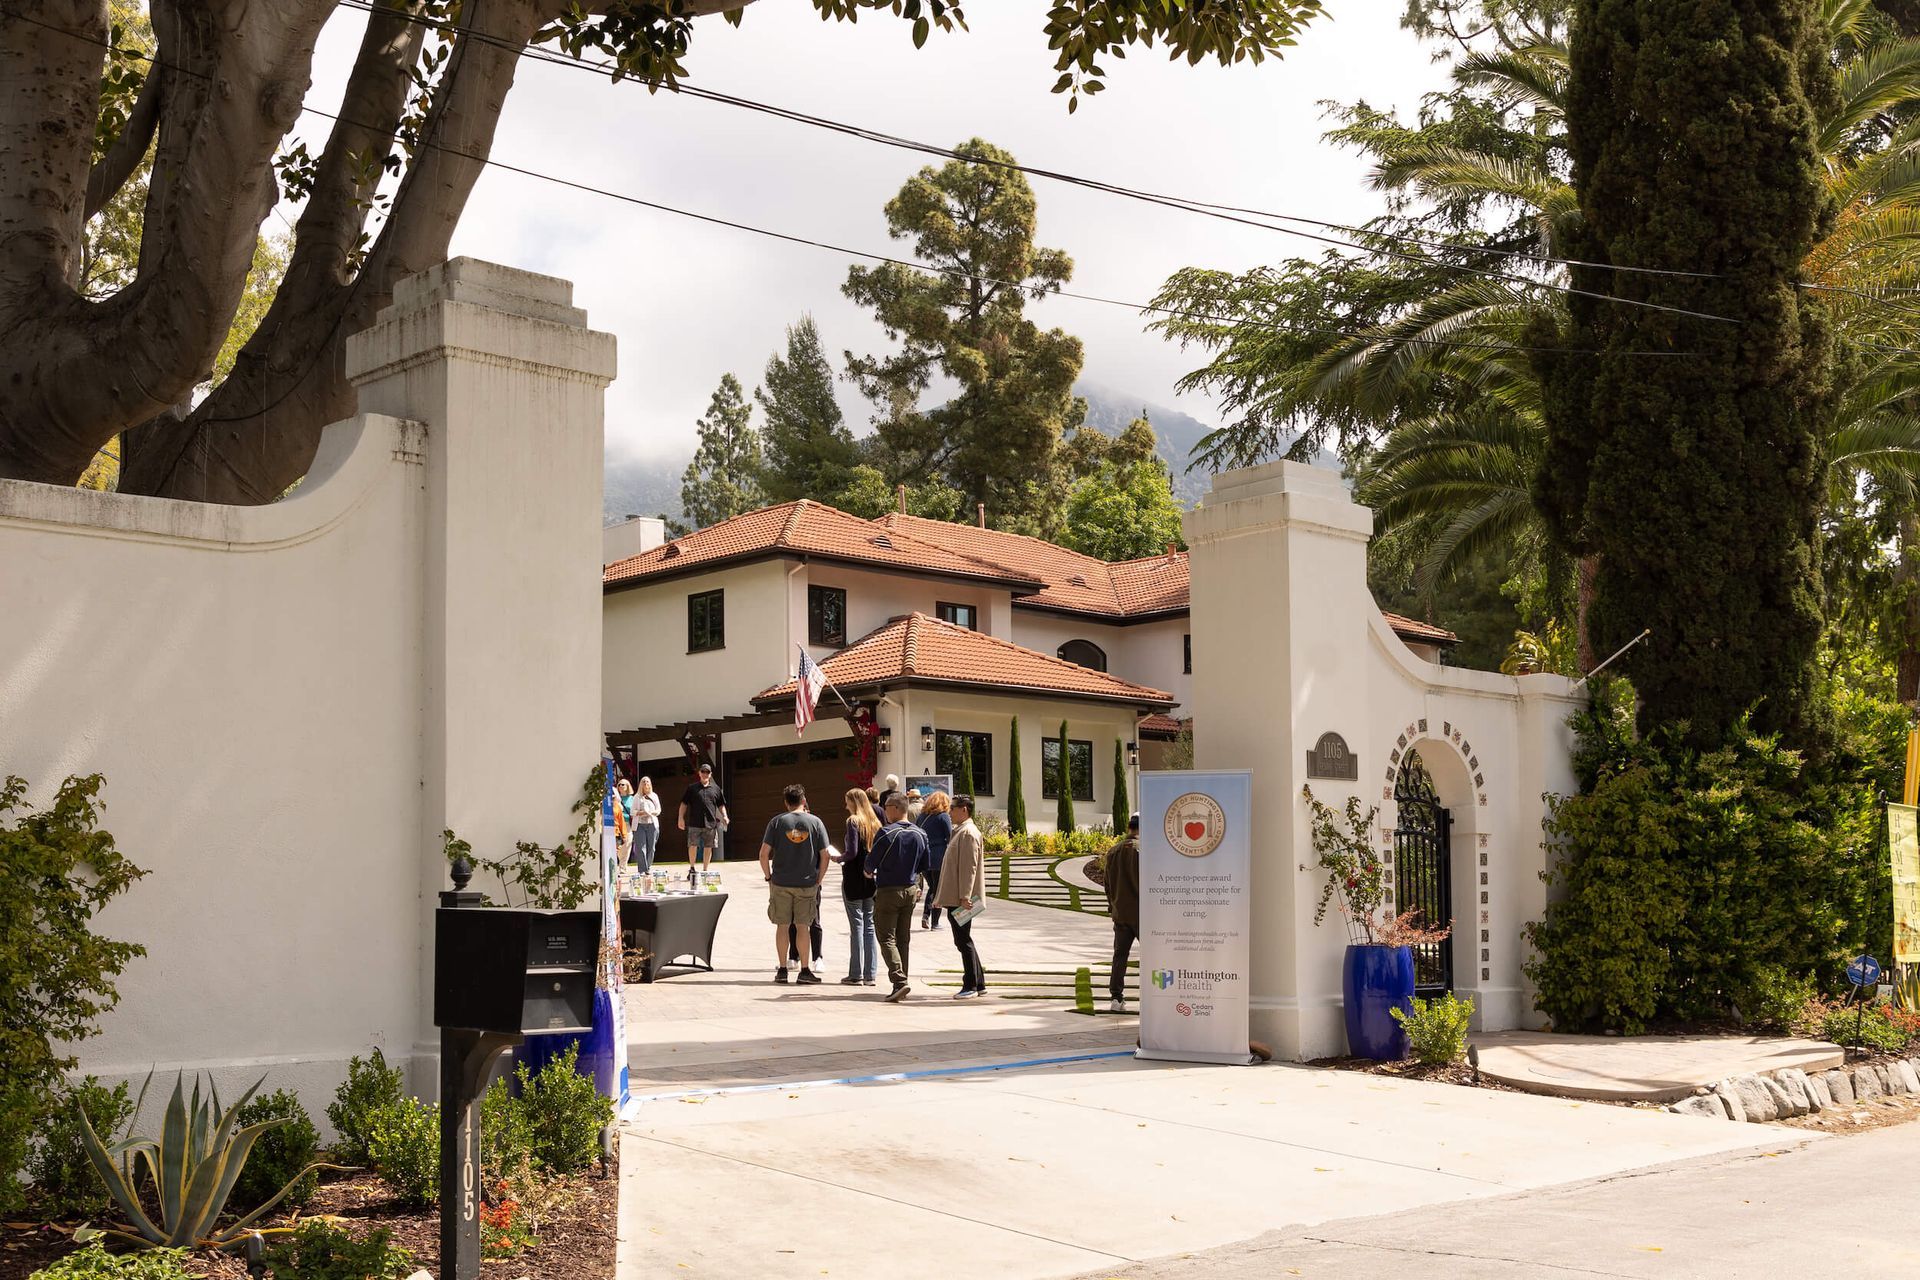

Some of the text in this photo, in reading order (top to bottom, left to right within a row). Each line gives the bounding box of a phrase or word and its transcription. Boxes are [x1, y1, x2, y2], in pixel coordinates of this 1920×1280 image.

[1323, 741, 1342, 759] 1105
[1165, 875, 1209, 884] peer-to-peer
[1209, 874, 1232, 882] award
[1149, 886, 1191, 895] recognizing
[1206, 886, 1229, 895] people
[1231, 886, 1241, 894] for
[1159, 897, 1230, 907] their compassionate
[1182, 909, 1207, 919] caring.
[1178, 980, 1212, 990] Health
[463, 1104, 474, 1221] 1105
